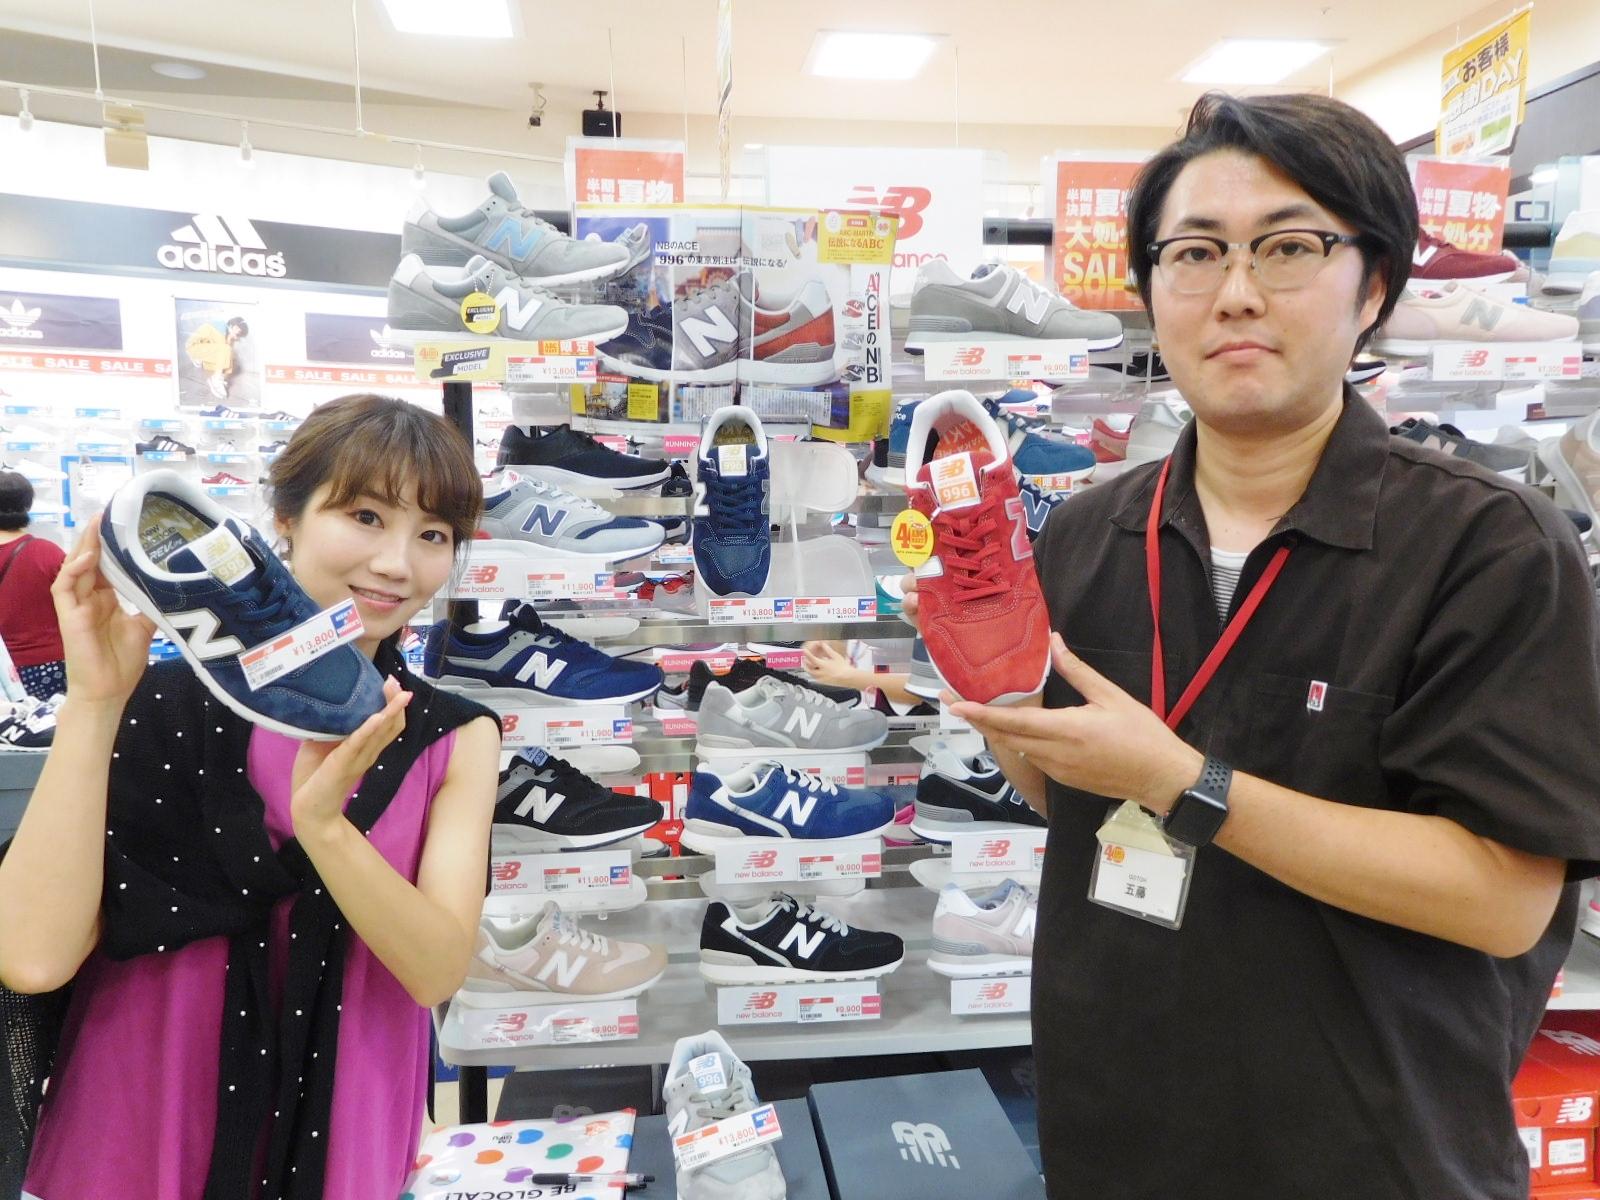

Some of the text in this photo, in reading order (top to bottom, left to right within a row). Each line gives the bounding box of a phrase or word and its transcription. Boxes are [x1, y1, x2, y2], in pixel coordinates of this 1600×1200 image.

[1462, 33, 1510, 84] お客様
[656, 241, 698, 250] NBのACE
[157, 241, 287, 278] adidas
[1063, 252, 1129, 285] SAL
[444, 349, 488, 362] EXCLUSIVE
[45, 357, 91, 370] SALE
[100, 361, 145, 373] SALE
[457, 363, 482, 372] MODEL
[267, 369, 286, 379] LE
[294, 370, 333, 382] SALE
[341, 372, 377, 383] SALE
[666, 439, 698, 448] RUNNING
[942, 485, 970, 502] 996
[473, 585, 505, 593] balance
[743, 608, 773, 616] ¥13,800
[827, 607, 857, 615] ¥13,800
[293, 628, 336, 657] ¥13,800
[752, 870, 784, 878] balance
[699, 1074, 721, 1088] 996
[551, 1184, 577, 1197] BE
